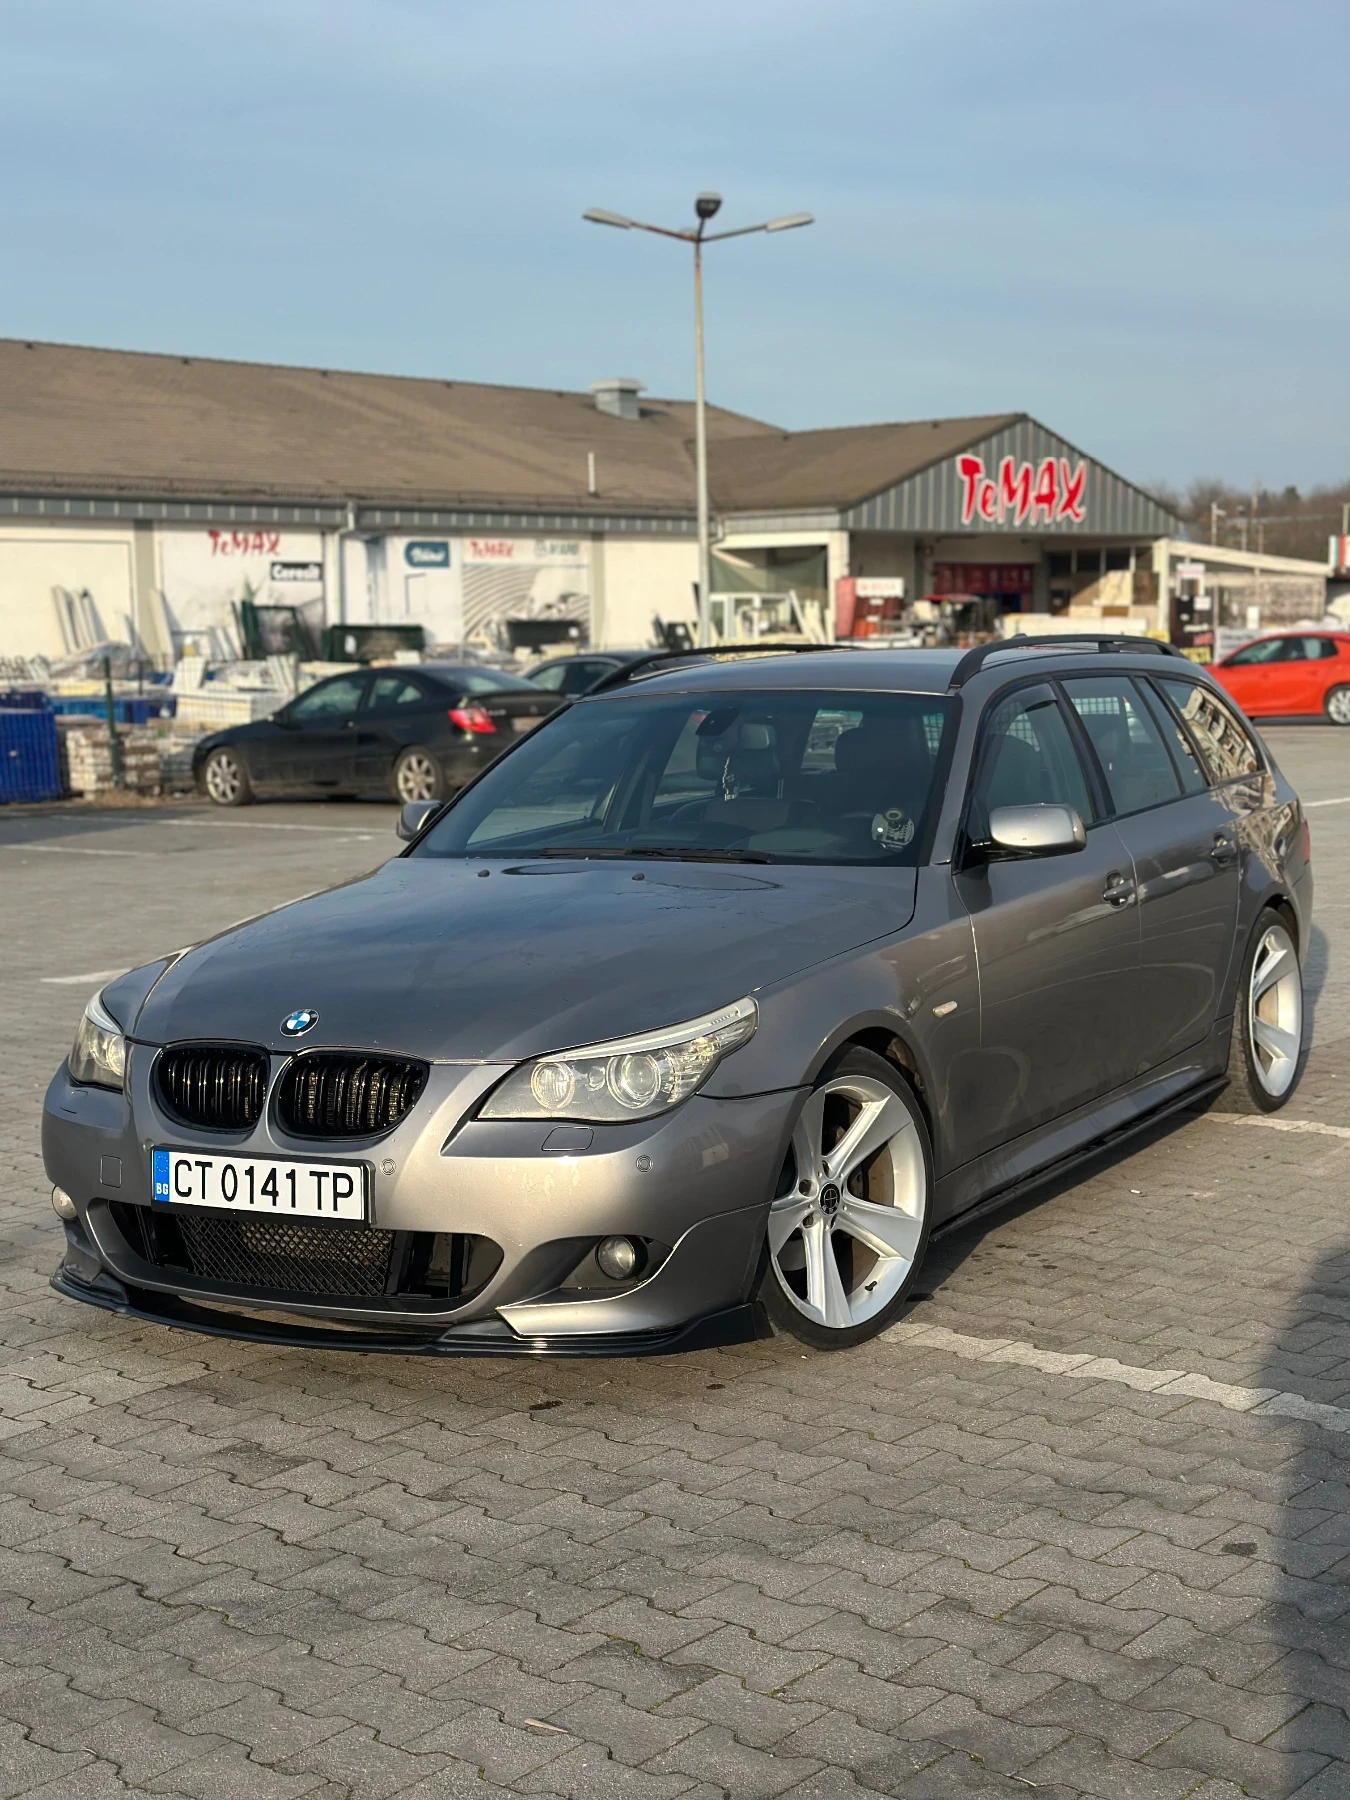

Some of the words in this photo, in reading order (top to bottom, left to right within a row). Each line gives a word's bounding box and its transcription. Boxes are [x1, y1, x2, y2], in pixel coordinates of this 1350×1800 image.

[956, 453, 1087, 527] TeMAX
[208, 529, 280, 556] TeMAX
[156, 1182, 169, 1195] BG
[174, 1159, 213, 1200] CT
[221, 1164, 297, 1209] 0141
[309, 1170, 354, 1212] TP
